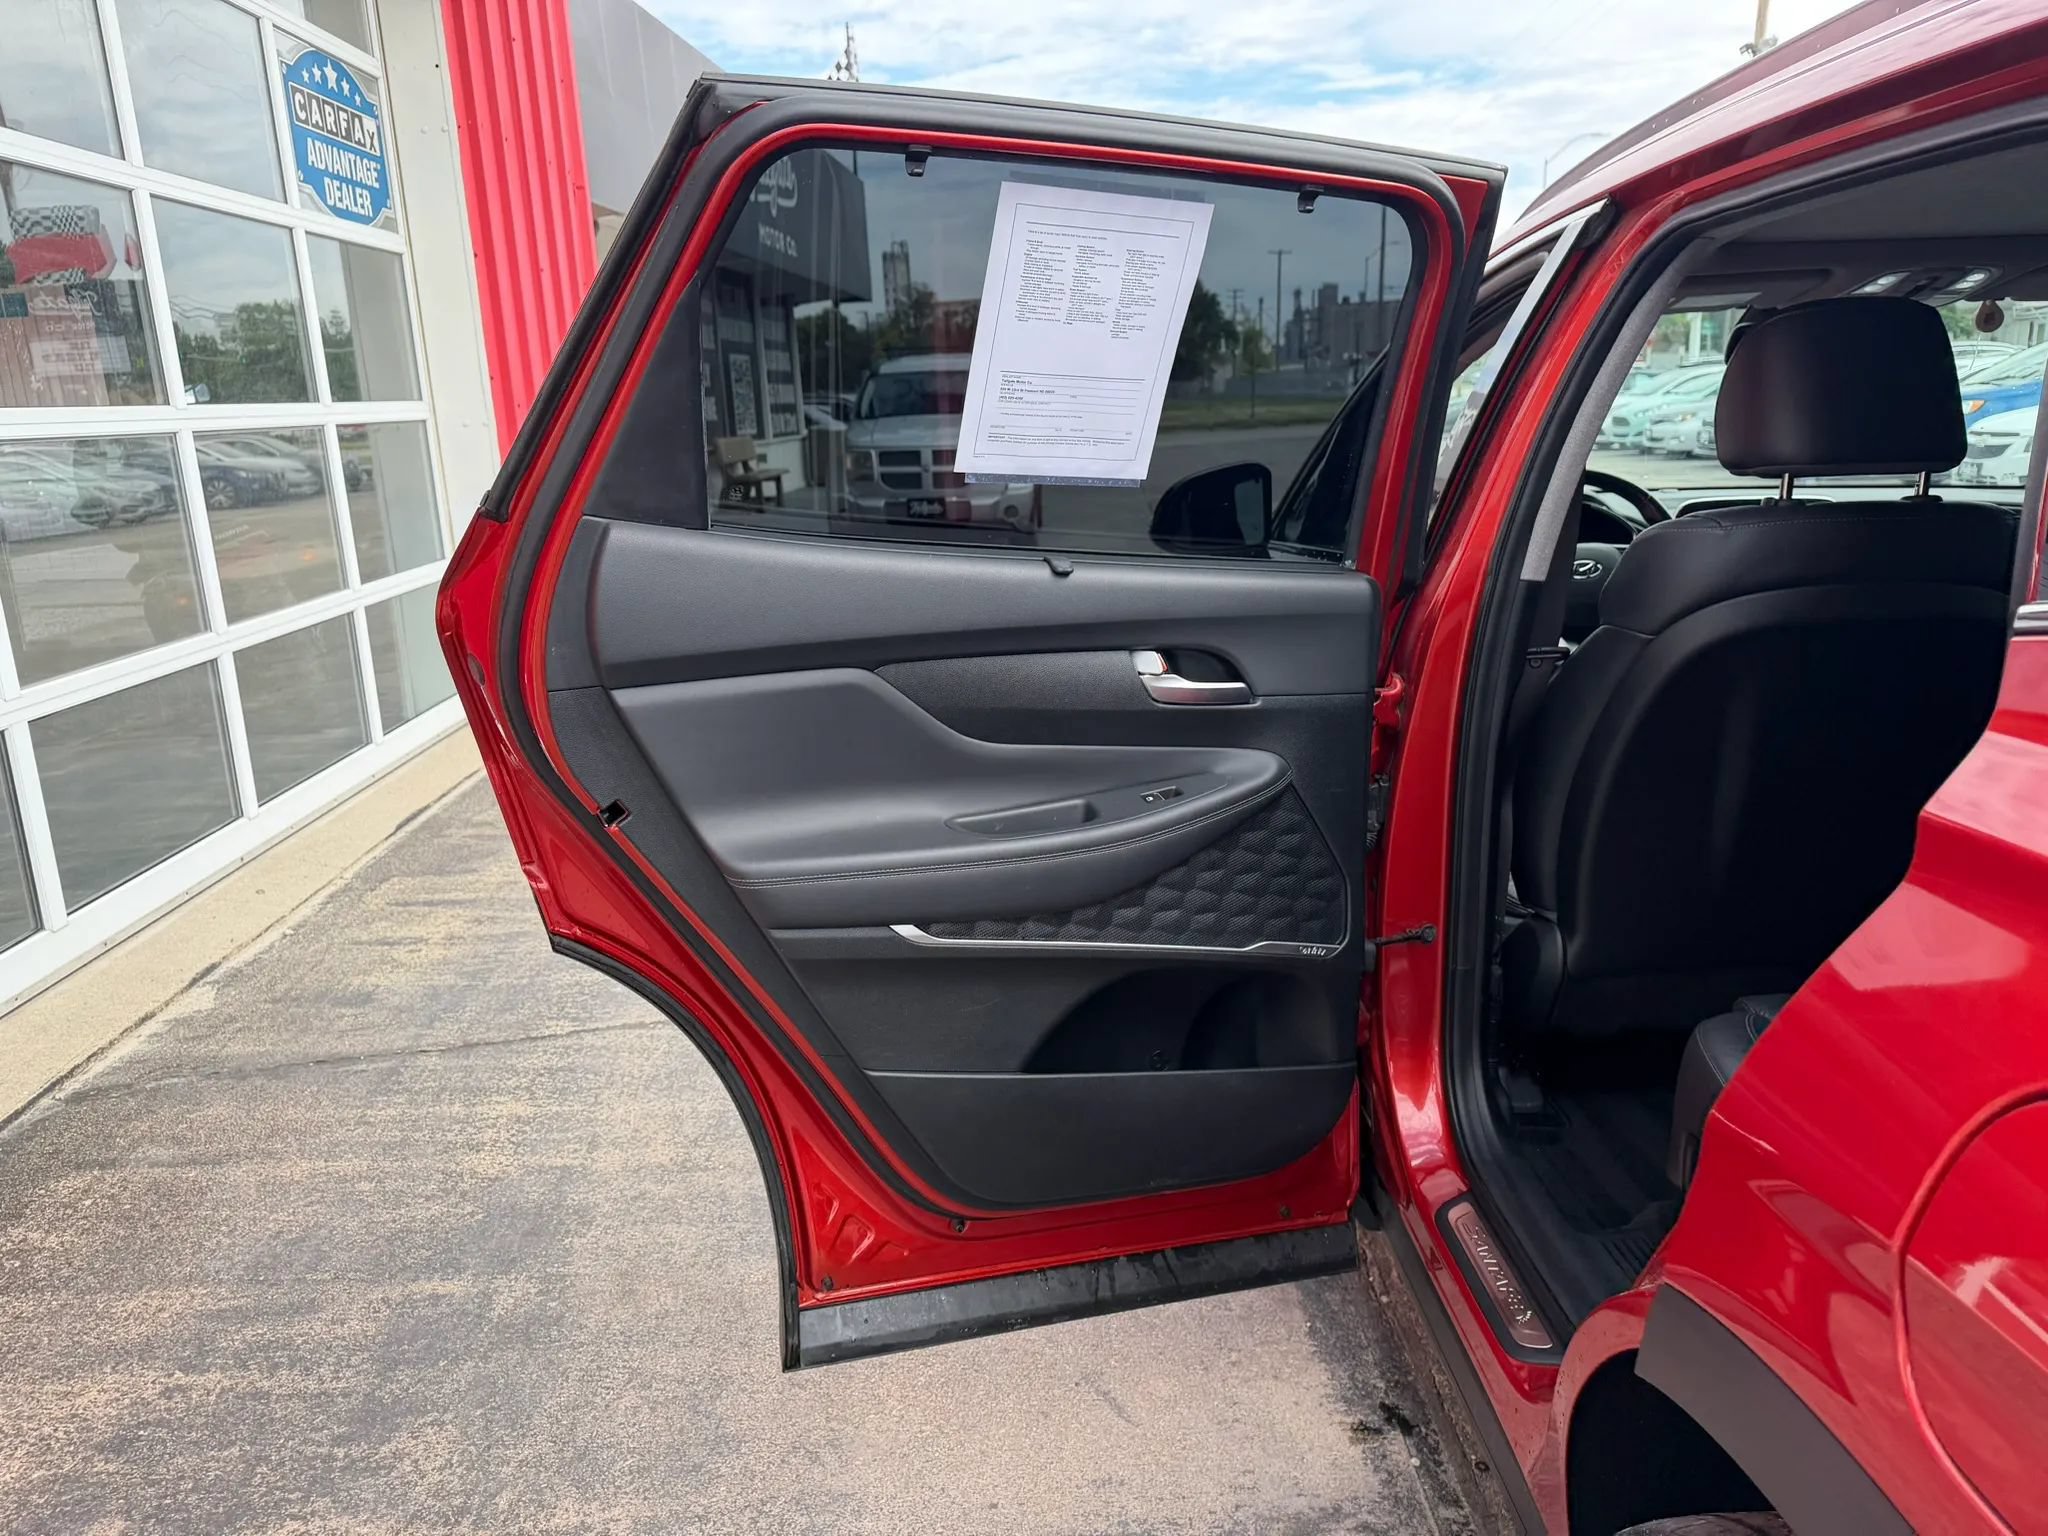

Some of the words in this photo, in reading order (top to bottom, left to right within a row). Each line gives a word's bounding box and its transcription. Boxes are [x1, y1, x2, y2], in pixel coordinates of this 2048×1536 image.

[294, 91, 378, 153] CARFAX
[306, 137, 380, 189] ADVANTAGE
[323, 176, 373, 218] DEALER
